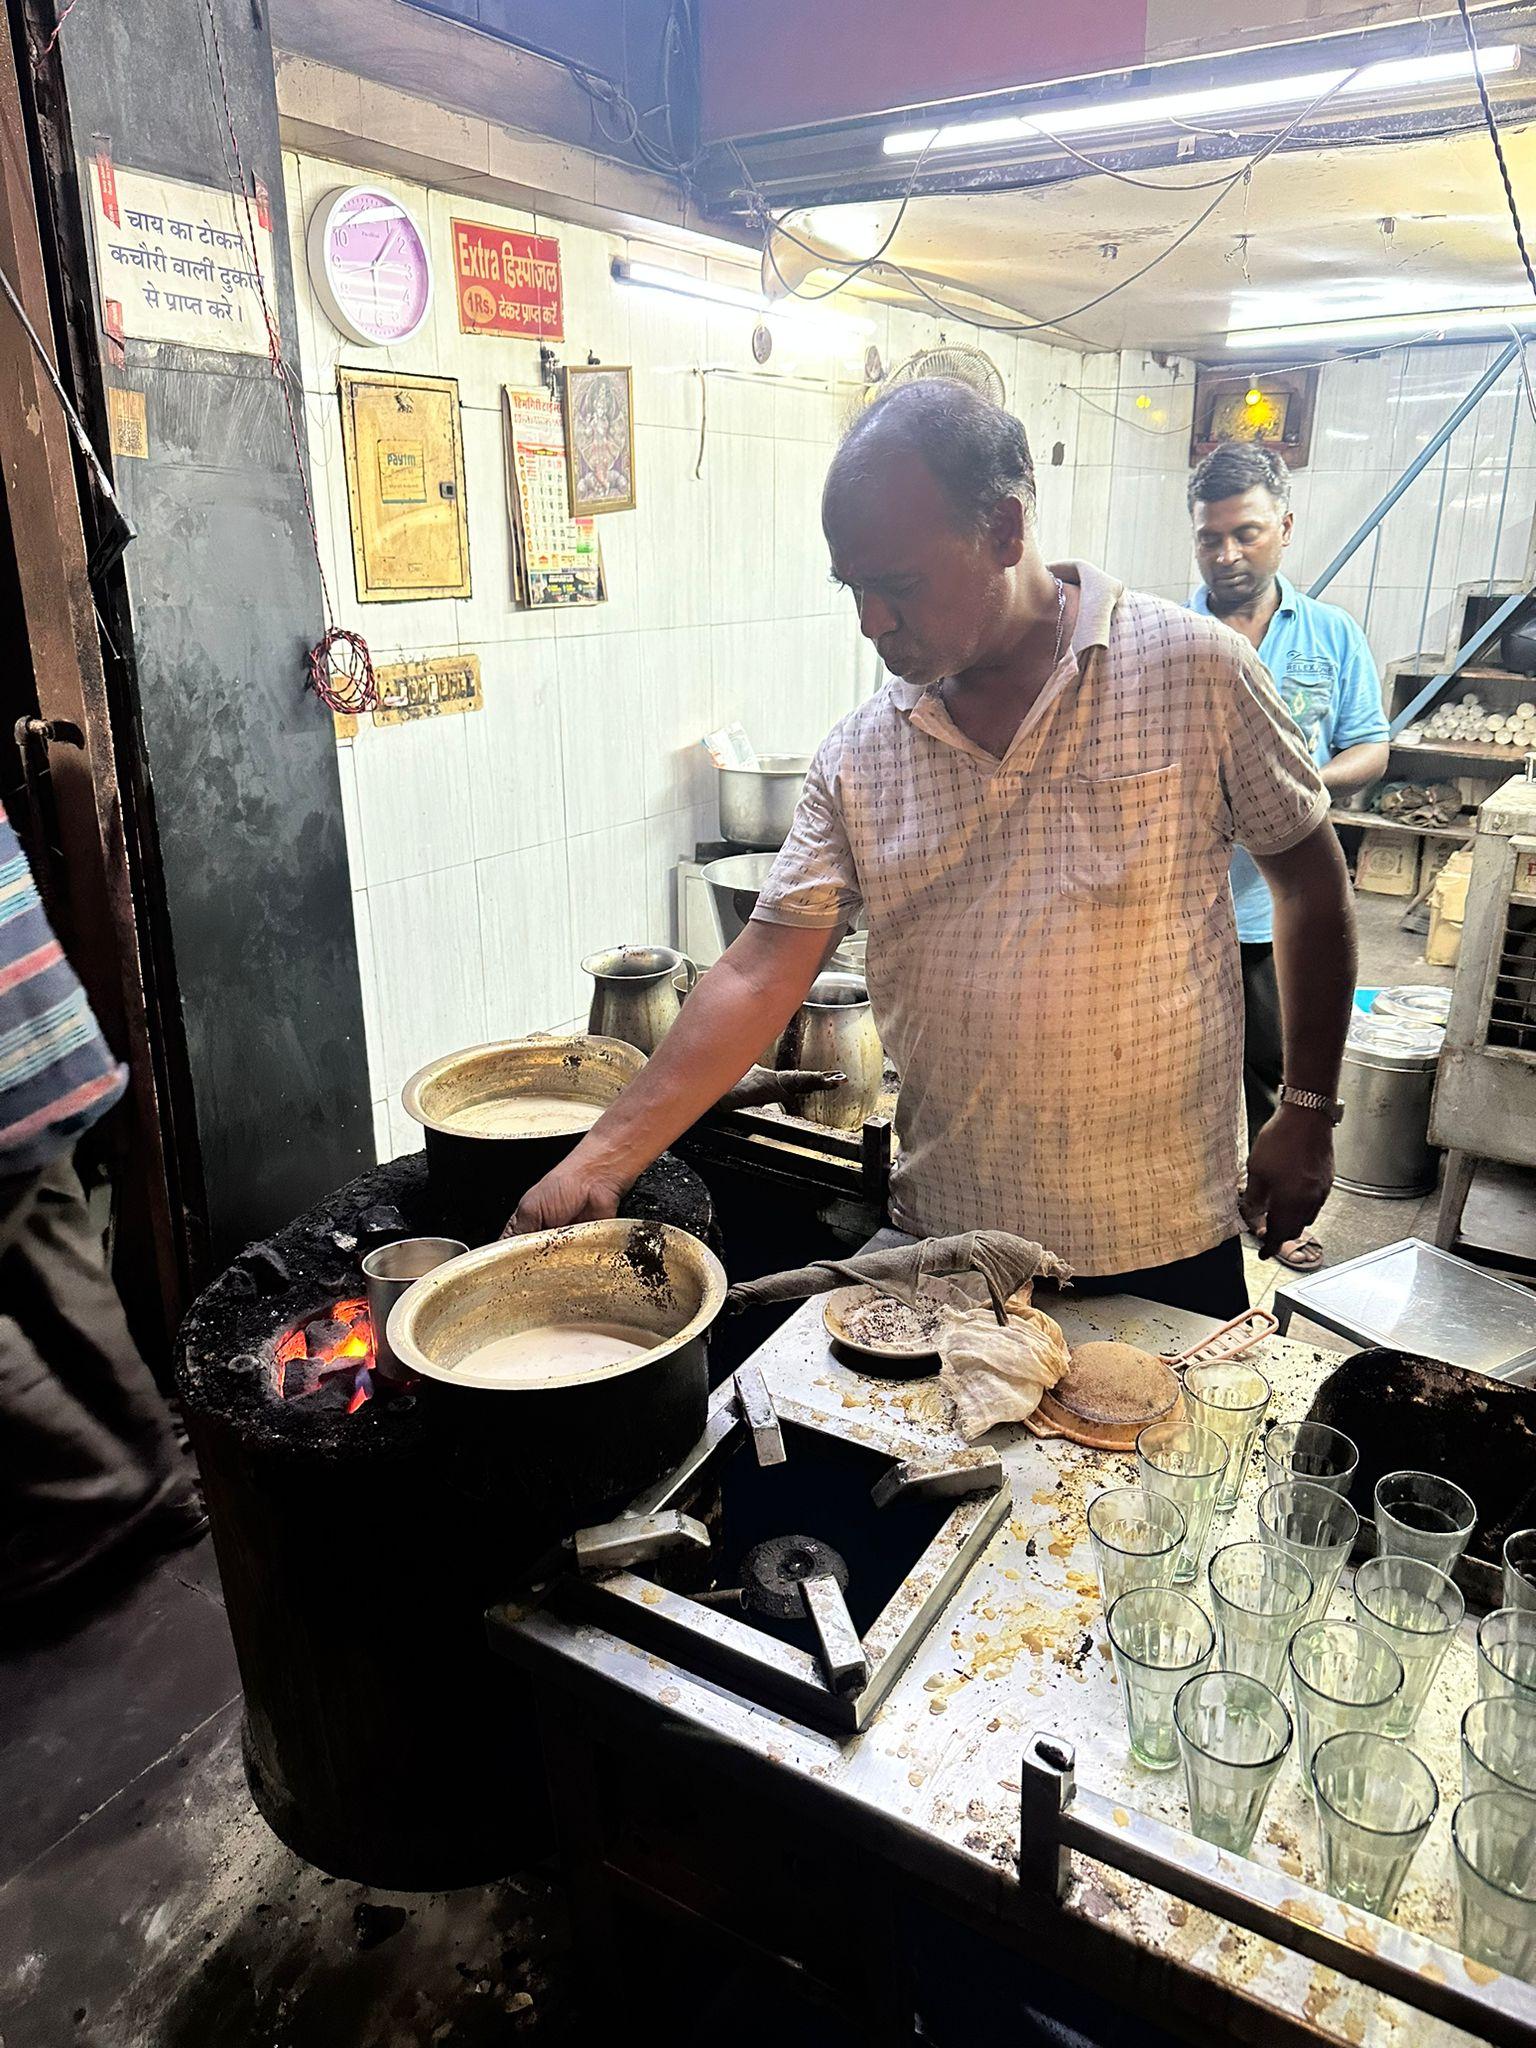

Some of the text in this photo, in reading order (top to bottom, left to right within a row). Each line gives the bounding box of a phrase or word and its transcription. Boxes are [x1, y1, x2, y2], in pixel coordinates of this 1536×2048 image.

[124, 209, 243, 251] चाय का टोकन
[333, 229, 347, 247] 10
[108, 242, 166, 273] कचौरी
[170, 257, 215, 282] वाली
[458, 233, 559, 292] Extra डिस्पोजल
[142, 281, 160, 308] से
[163, 292, 203, 314] प्राप्त
[498, 294, 521, 321] देकर
[521, 303, 541, 325] प्राप्त
[543, 301, 558, 326] करें
[387, 453, 416, 467] Paytm
